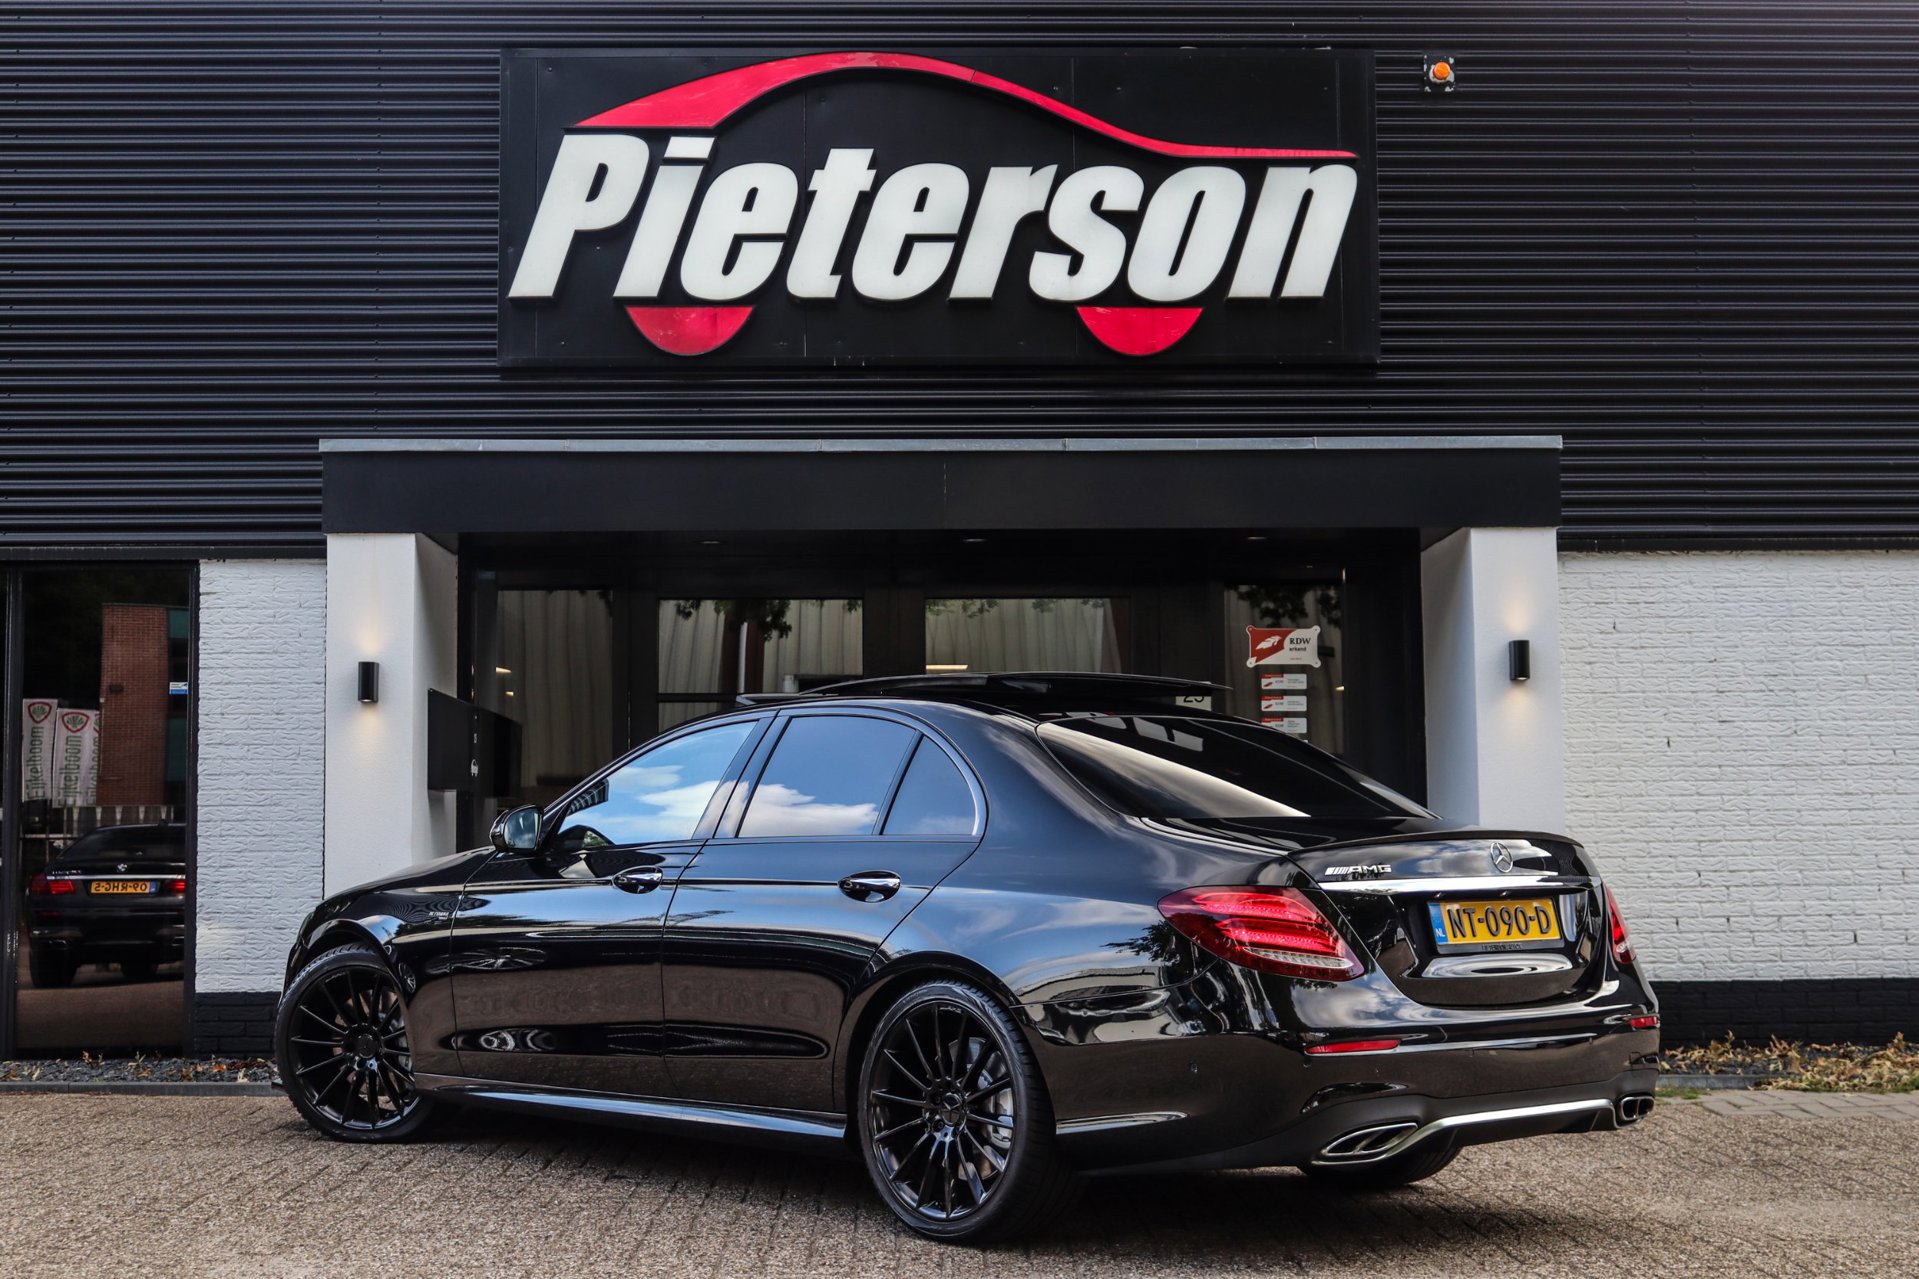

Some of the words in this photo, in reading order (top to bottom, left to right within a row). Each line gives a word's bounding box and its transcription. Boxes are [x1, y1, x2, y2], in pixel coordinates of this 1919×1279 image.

[507, 134, 1358, 303] Pieterson
[1289, 637, 1311, 645] RDW
[26, 726, 47, 800] Eijkelboom
[1347, 864, 1392, 875] AMG
[1435, 927, 1446, 938] NL
[1447, 905, 1552, 938] NT-090-D
